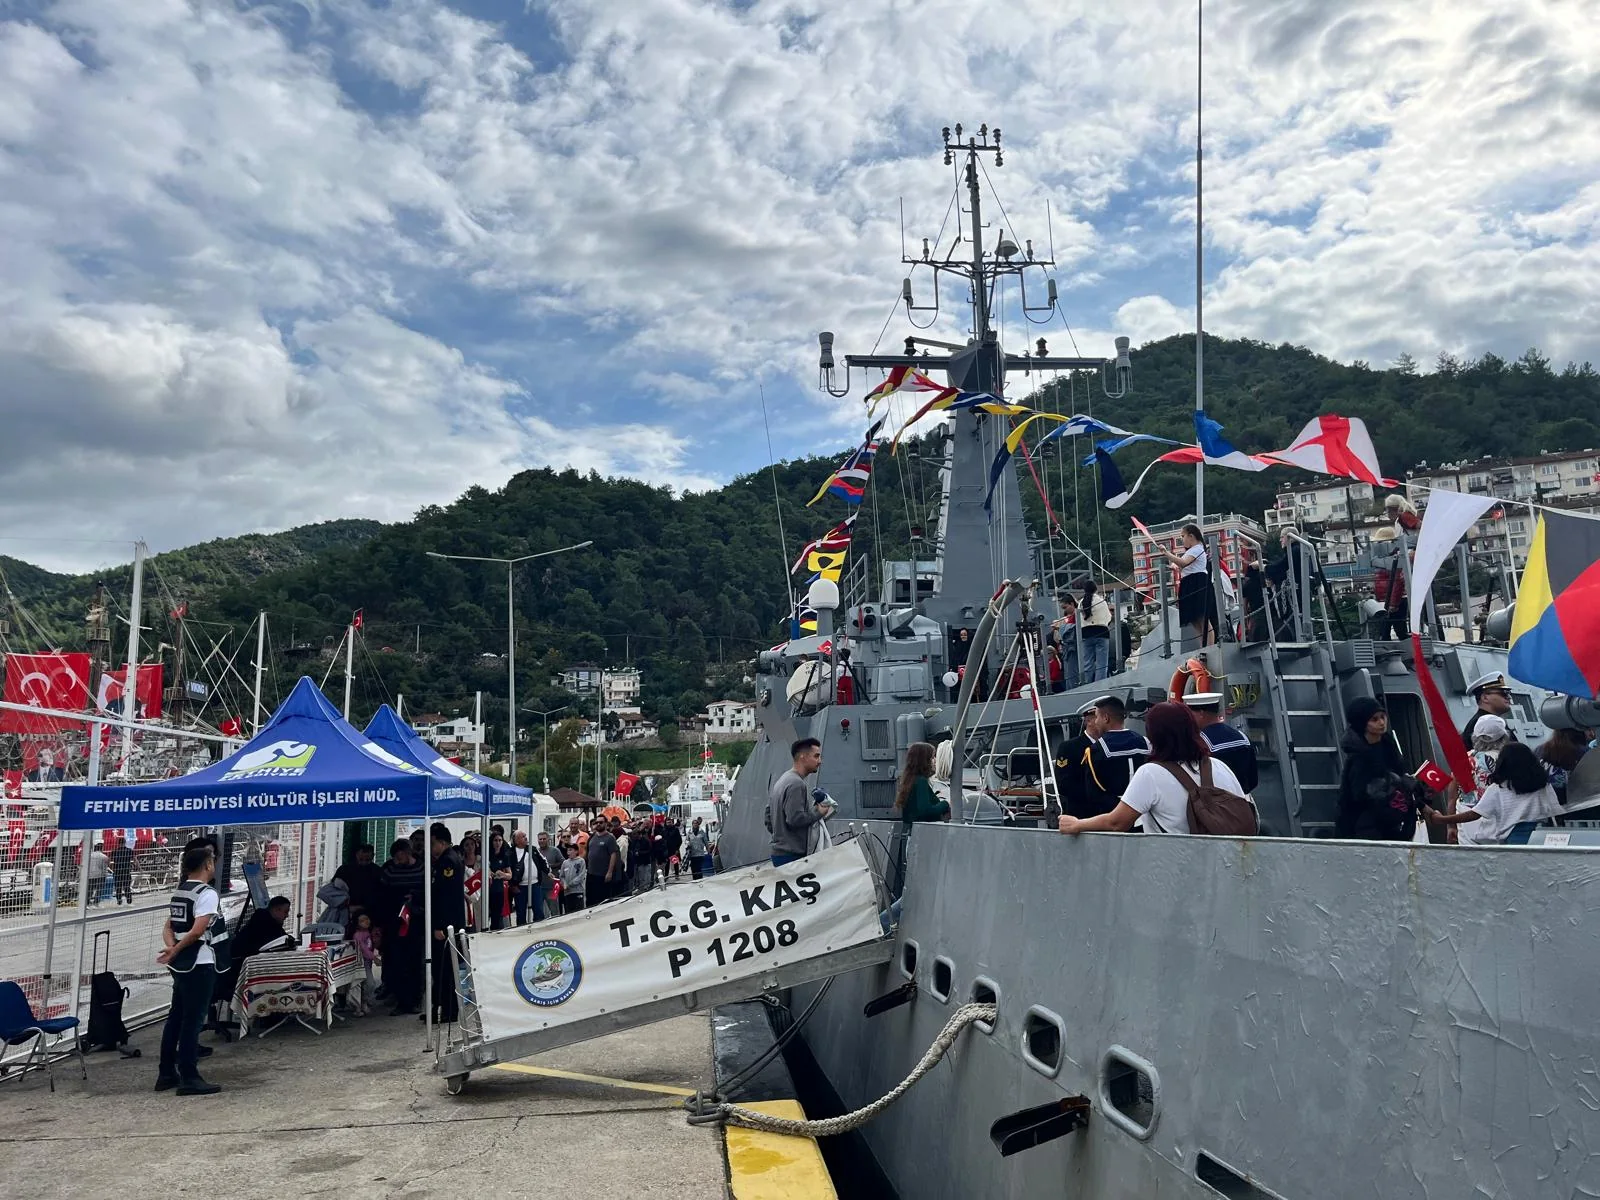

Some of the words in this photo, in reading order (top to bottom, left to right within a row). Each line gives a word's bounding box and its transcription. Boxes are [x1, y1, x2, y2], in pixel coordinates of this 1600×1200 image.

[84, 797, 150, 813] FETHİYE
[154, 793, 243, 812] BELEDİYESİ
[247, 791, 308, 808] KÜLTÜR
[312, 788, 359, 807] İŞLERİ
[364, 787, 400, 802] MÜD.
[609, 899, 731, 948] T.C.G.
[739, 872, 821, 917] KAŞ
[667, 947, 692, 979] P
[706, 919, 799, 967] 1208
